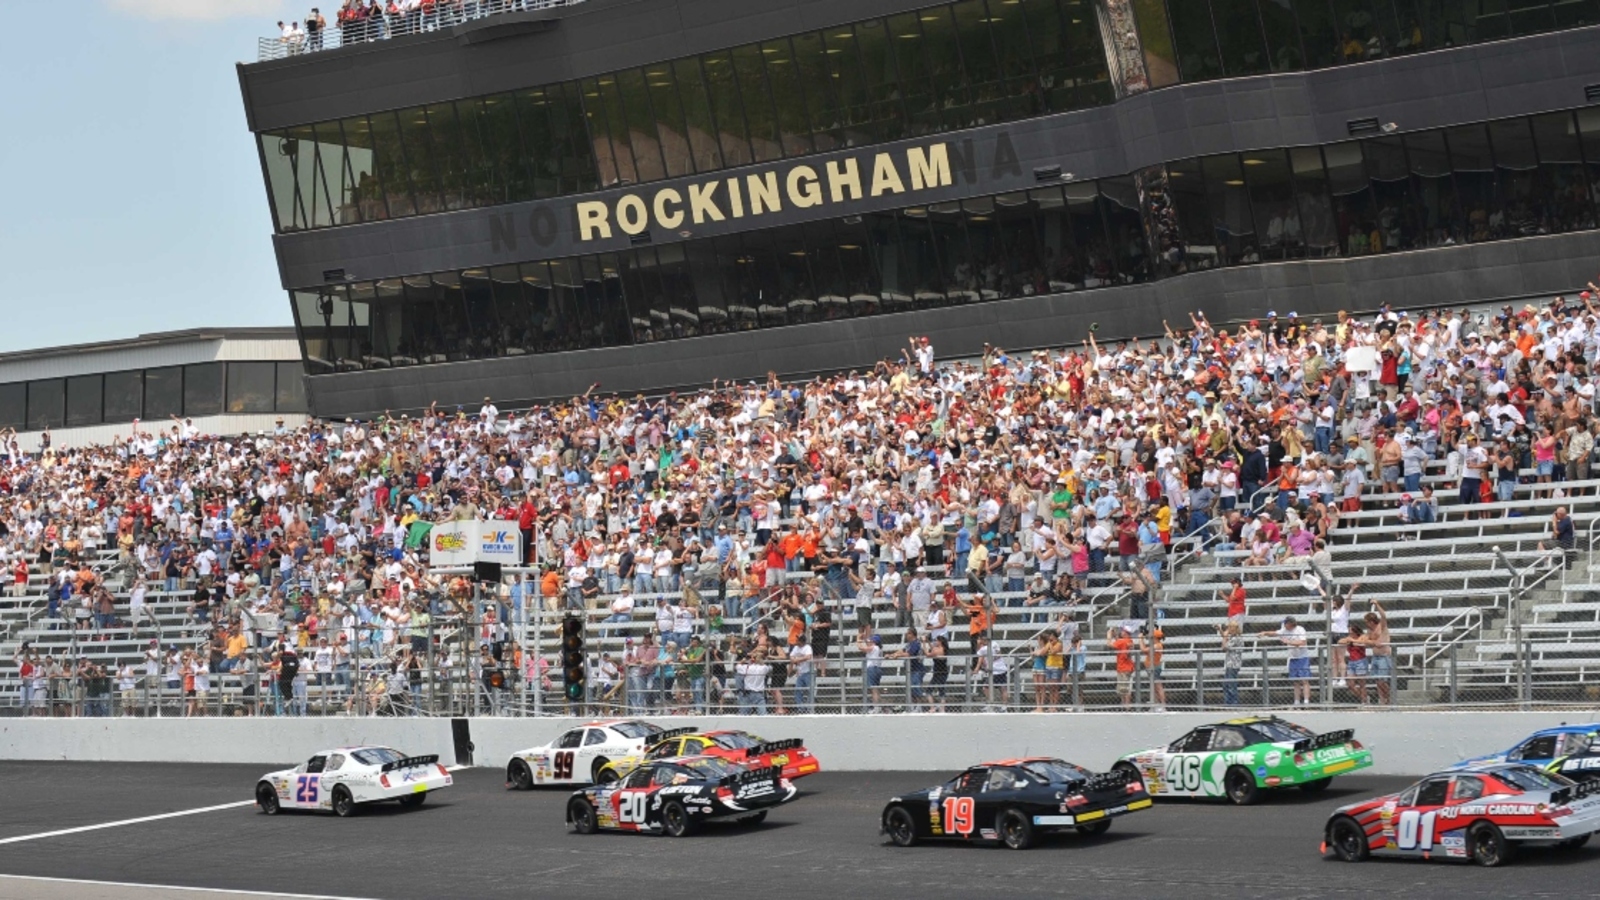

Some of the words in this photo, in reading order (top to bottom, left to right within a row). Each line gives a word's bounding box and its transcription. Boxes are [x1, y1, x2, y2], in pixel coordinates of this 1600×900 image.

[577, 143, 953, 241] ROCKINGHAM
[553, 751, 575, 779] 99
[1166, 755, 1201, 791] 46
[296, 774, 319, 803] 25
[619, 791, 647, 823] 20
[943, 797, 975, 834] 19
[1488, 805, 1534, 815] CAROLINA
[1398, 809, 1437, 851] 01
